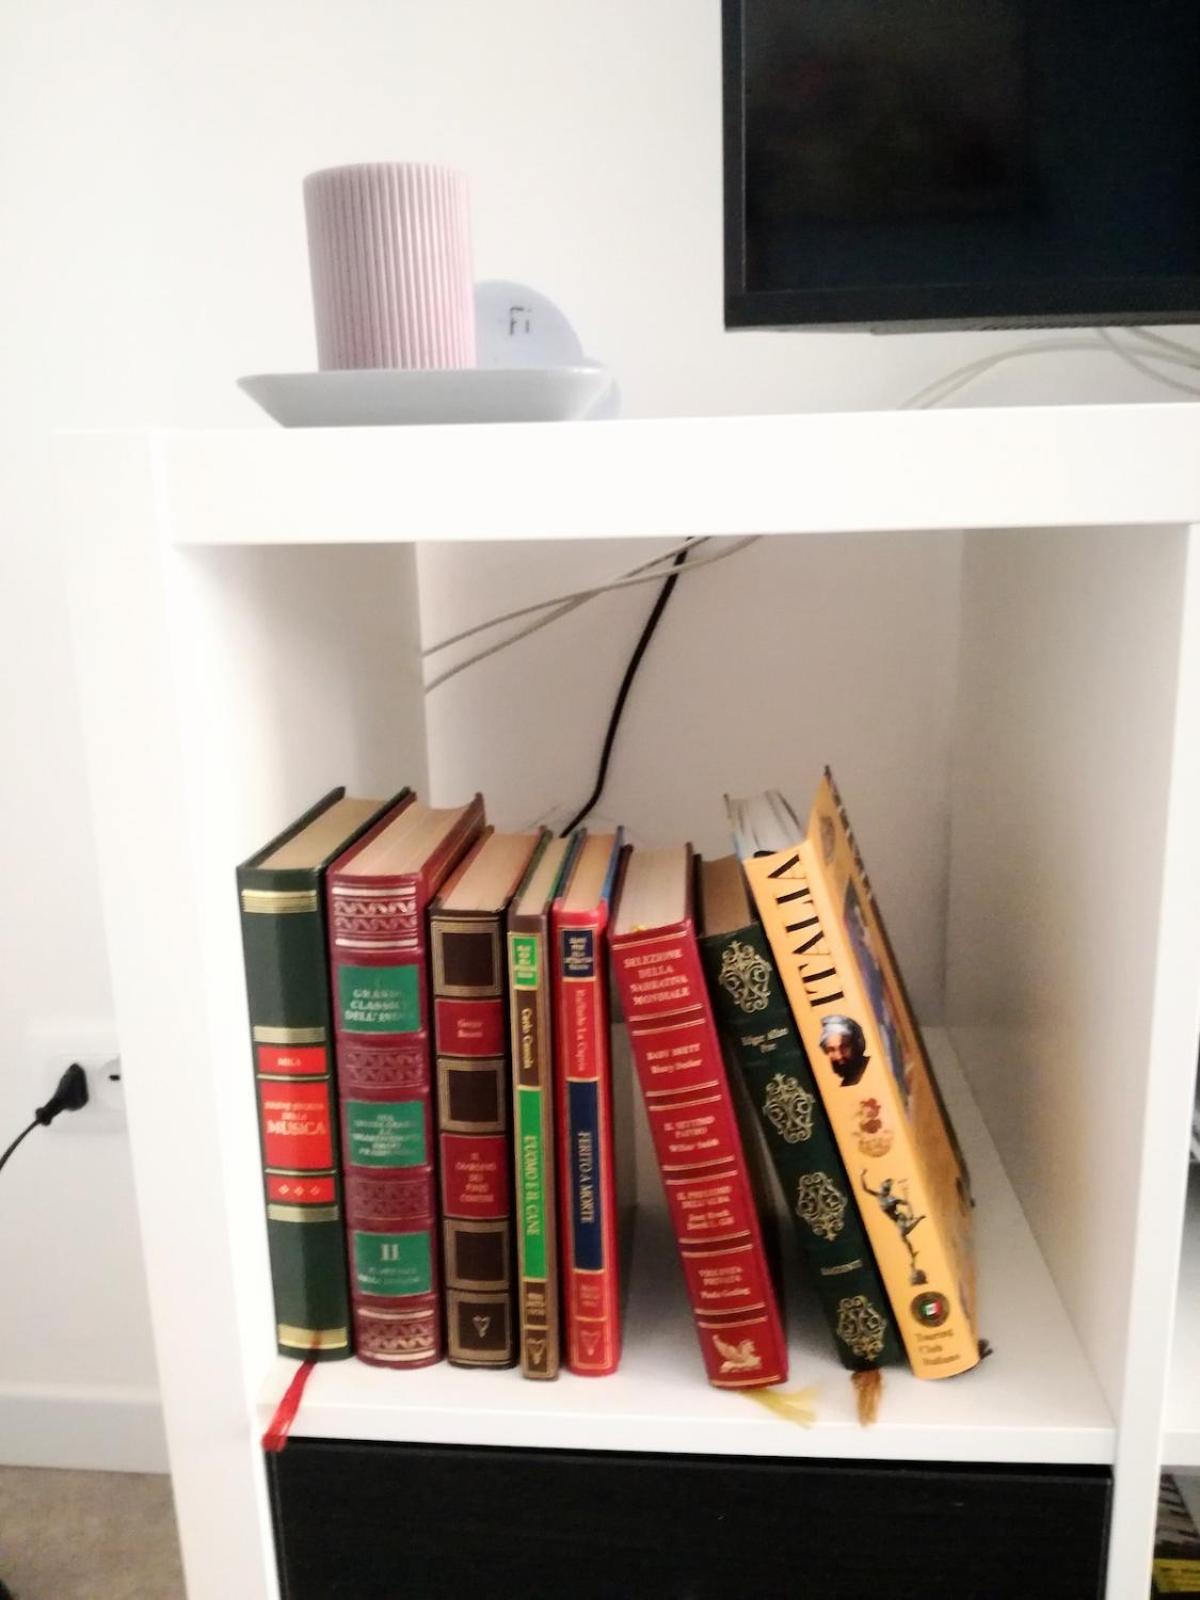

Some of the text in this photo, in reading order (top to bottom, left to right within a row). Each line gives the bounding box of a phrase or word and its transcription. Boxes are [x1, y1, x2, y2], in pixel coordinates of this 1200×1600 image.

[767, 854, 845, 1009] ITALIA
[266, 1120, 326, 1136] MUSICA
[580, 1185, 595, 1224] MORTE
